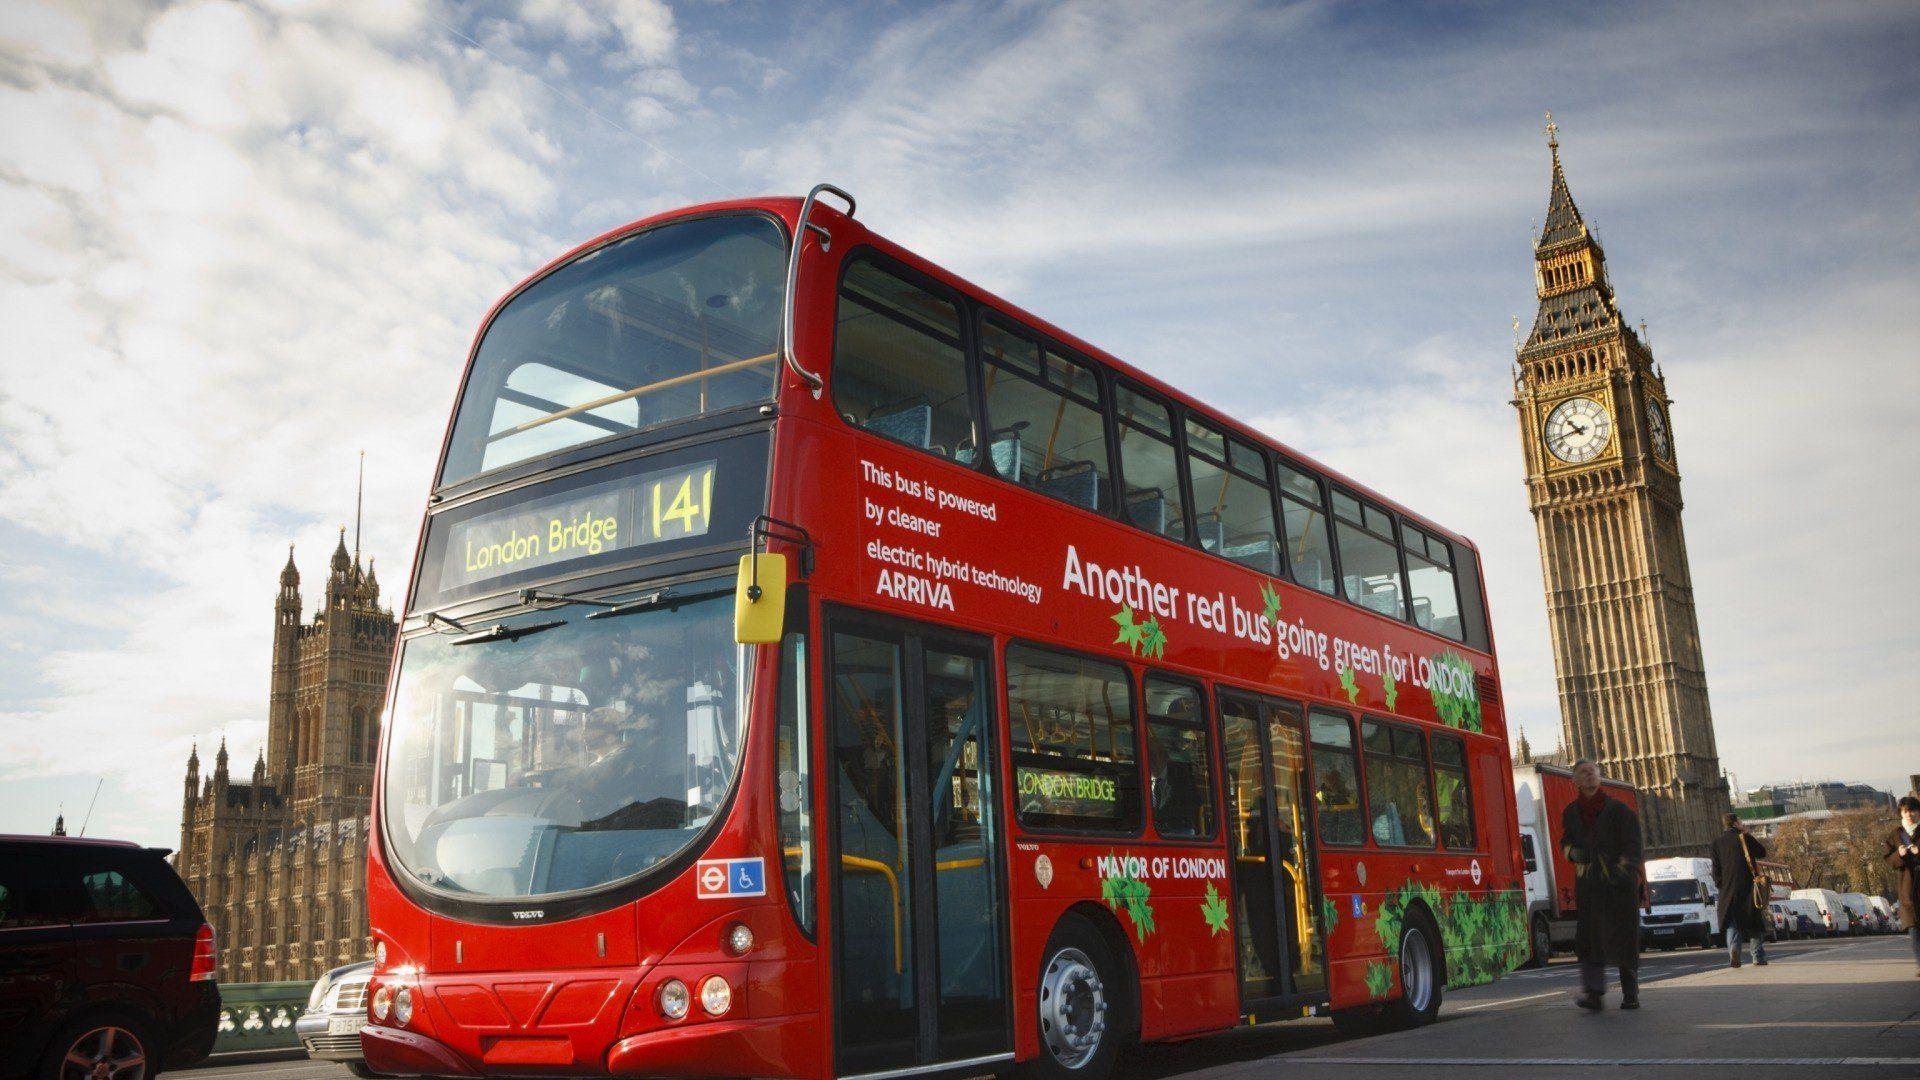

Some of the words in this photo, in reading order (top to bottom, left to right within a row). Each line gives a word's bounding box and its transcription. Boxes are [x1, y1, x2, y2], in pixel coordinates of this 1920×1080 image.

[652, 469, 712, 539] 141
[860, 459, 892, 489] This
[895, 470, 921, 498] bus
[923, 480, 936, 503] is
[938, 490, 997, 522] powered
[864, 497, 884, 526] by
[887, 506, 941, 538] cleaner
[466, 530, 540, 572] London
[548, 511, 618, 555] Bridge
[866, 538, 924, 571] electric
[926, 552, 969, 582] hybrid
[972, 566, 1042, 604] technology
[876, 568, 955, 612] ARRIVA
[1062, 544, 1180, 620] Another
[1186, 591, 1226, 634] red
[1231, 596, 1272, 646] bus
[1276, 617, 1330, 671] going
[1333, 636, 1382, 676] green
[1383, 644, 1407, 683] for
[1409, 652, 1475, 702] LONDON
[1017, 769, 1075, 798] LONDON
[1076, 777, 1116, 801] BRIDGE
[1097, 856, 1150, 879] MAYOR
[1151, 857, 1170, 879] OF
[1172, 857, 1227, 879] LONDON
